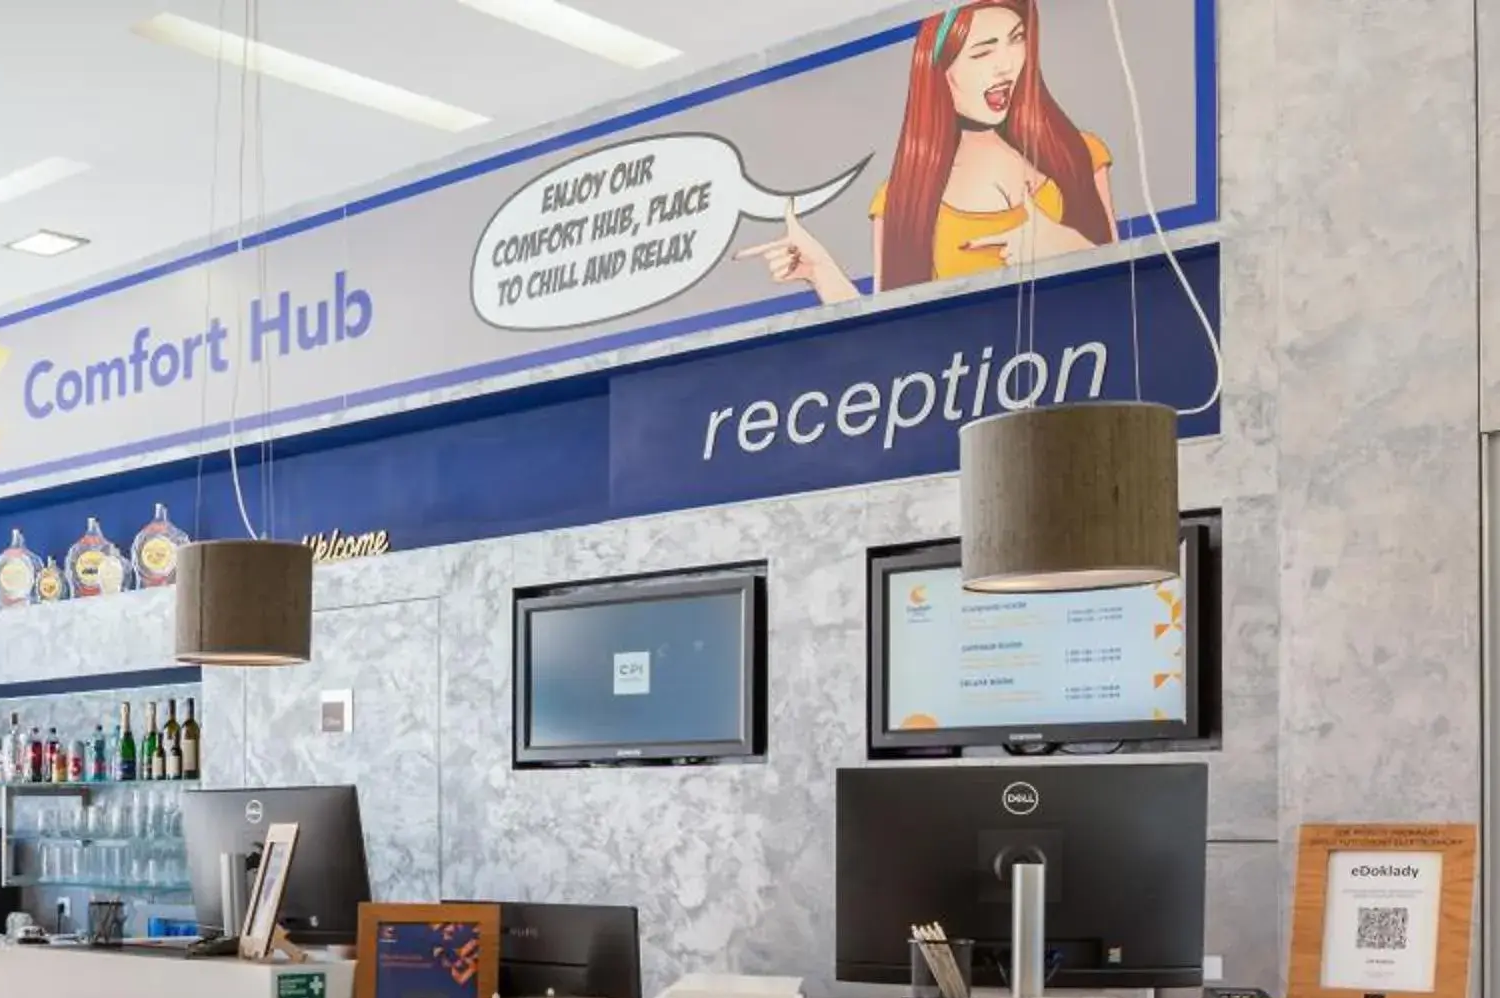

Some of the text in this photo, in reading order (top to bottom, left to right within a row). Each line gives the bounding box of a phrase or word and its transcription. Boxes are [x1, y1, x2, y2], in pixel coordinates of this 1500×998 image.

[492, 181, 712, 267] COMFORT HUB, PLACE
[541, 155, 655, 214] ENJOY OUR
[498, 231, 697, 306] TO CHILL AND RELAX
[24, 271, 373, 419] Comfort Hub
[703, 341, 1108, 460] reception
[1351, 864, 1420, 878] eDoklady
